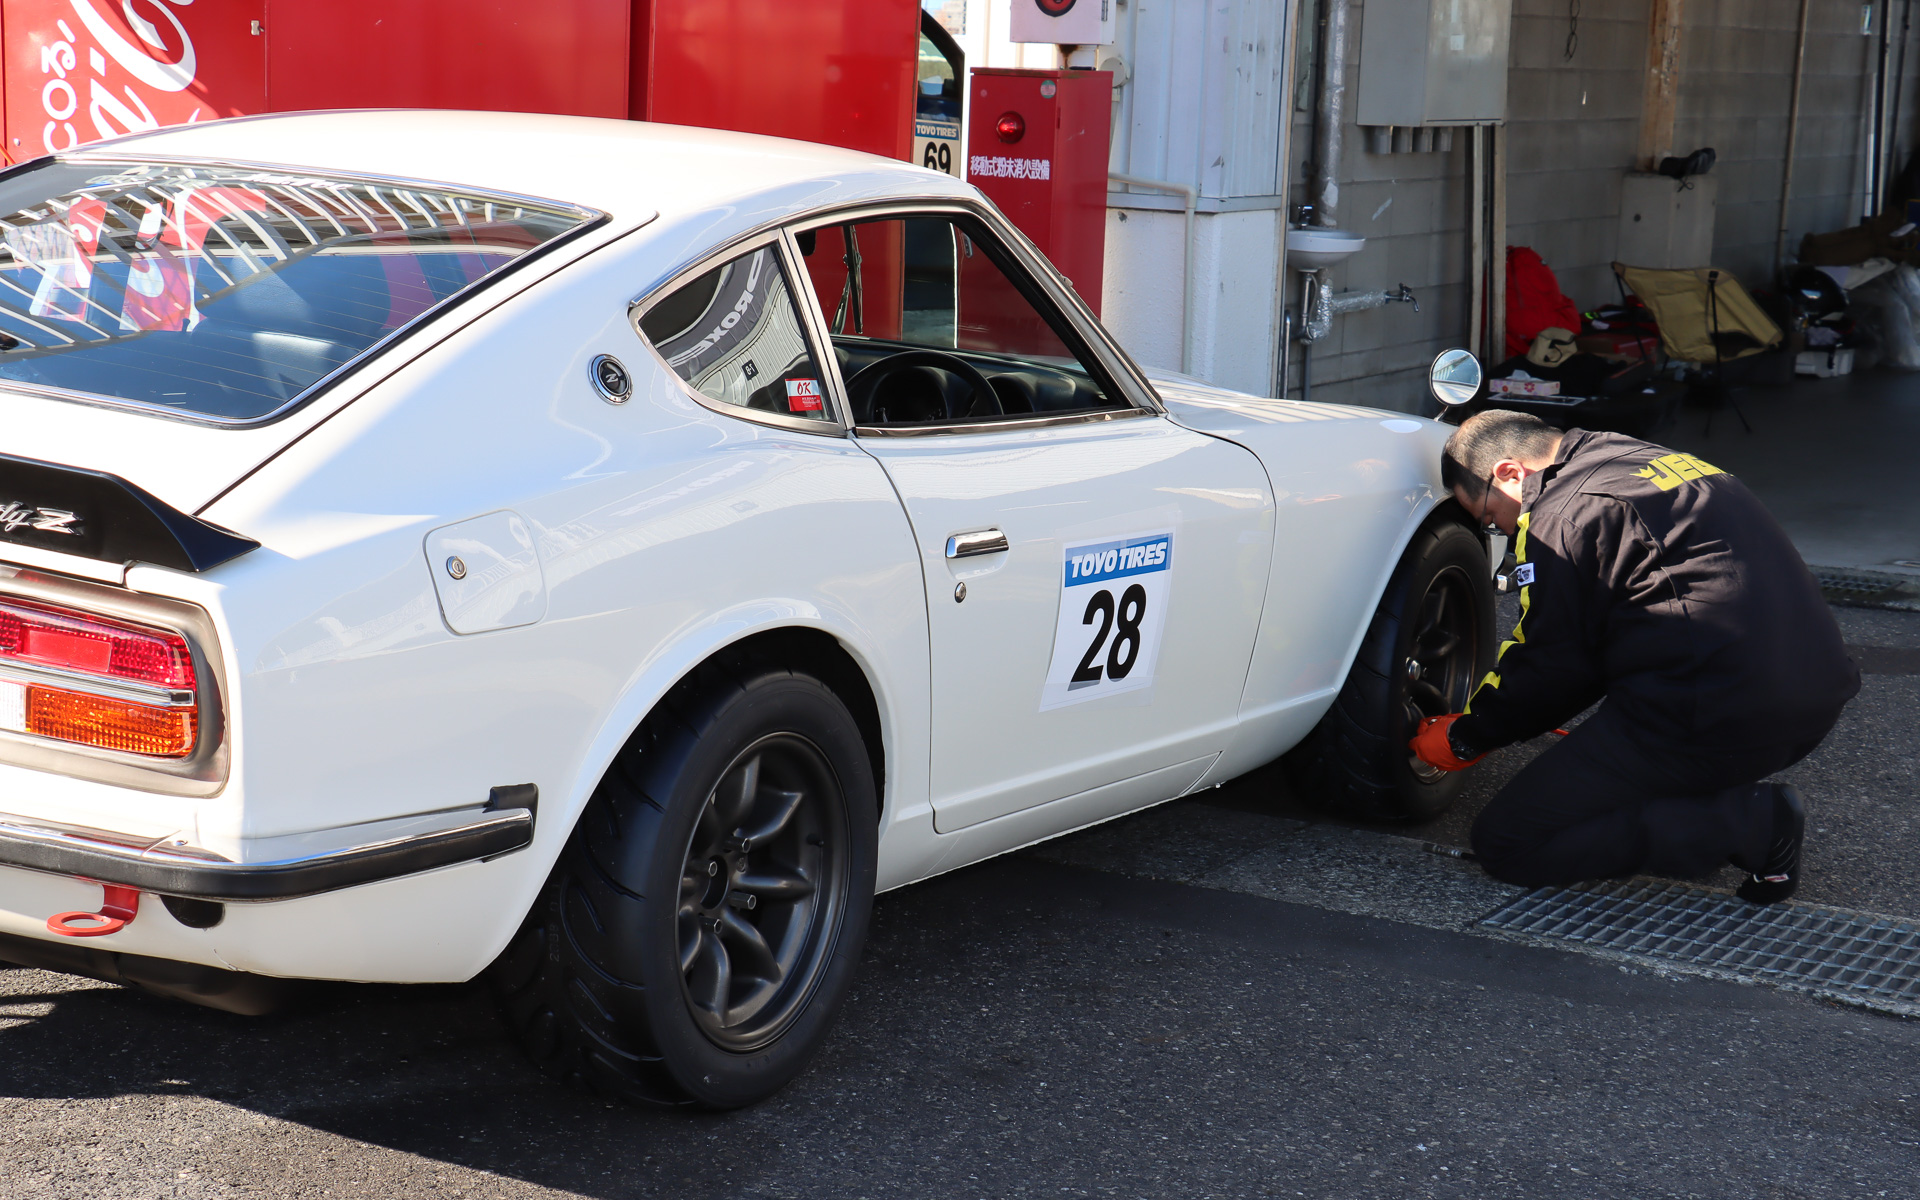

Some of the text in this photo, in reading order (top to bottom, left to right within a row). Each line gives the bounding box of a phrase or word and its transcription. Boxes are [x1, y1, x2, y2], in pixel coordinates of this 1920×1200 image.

[916, 124, 957, 138] TOYO TIRES
[923, 141, 951, 175] 69
[970, 155, 1050, 180] 移動式粉末消火設備
[797, 381, 811, 395] OK
[1647, 453, 1733, 491] JEG
[33, 507, 80, 534] Z
[1072, 541, 1168, 579] TOYO TIRES
[1067, 583, 1147, 691] 28
